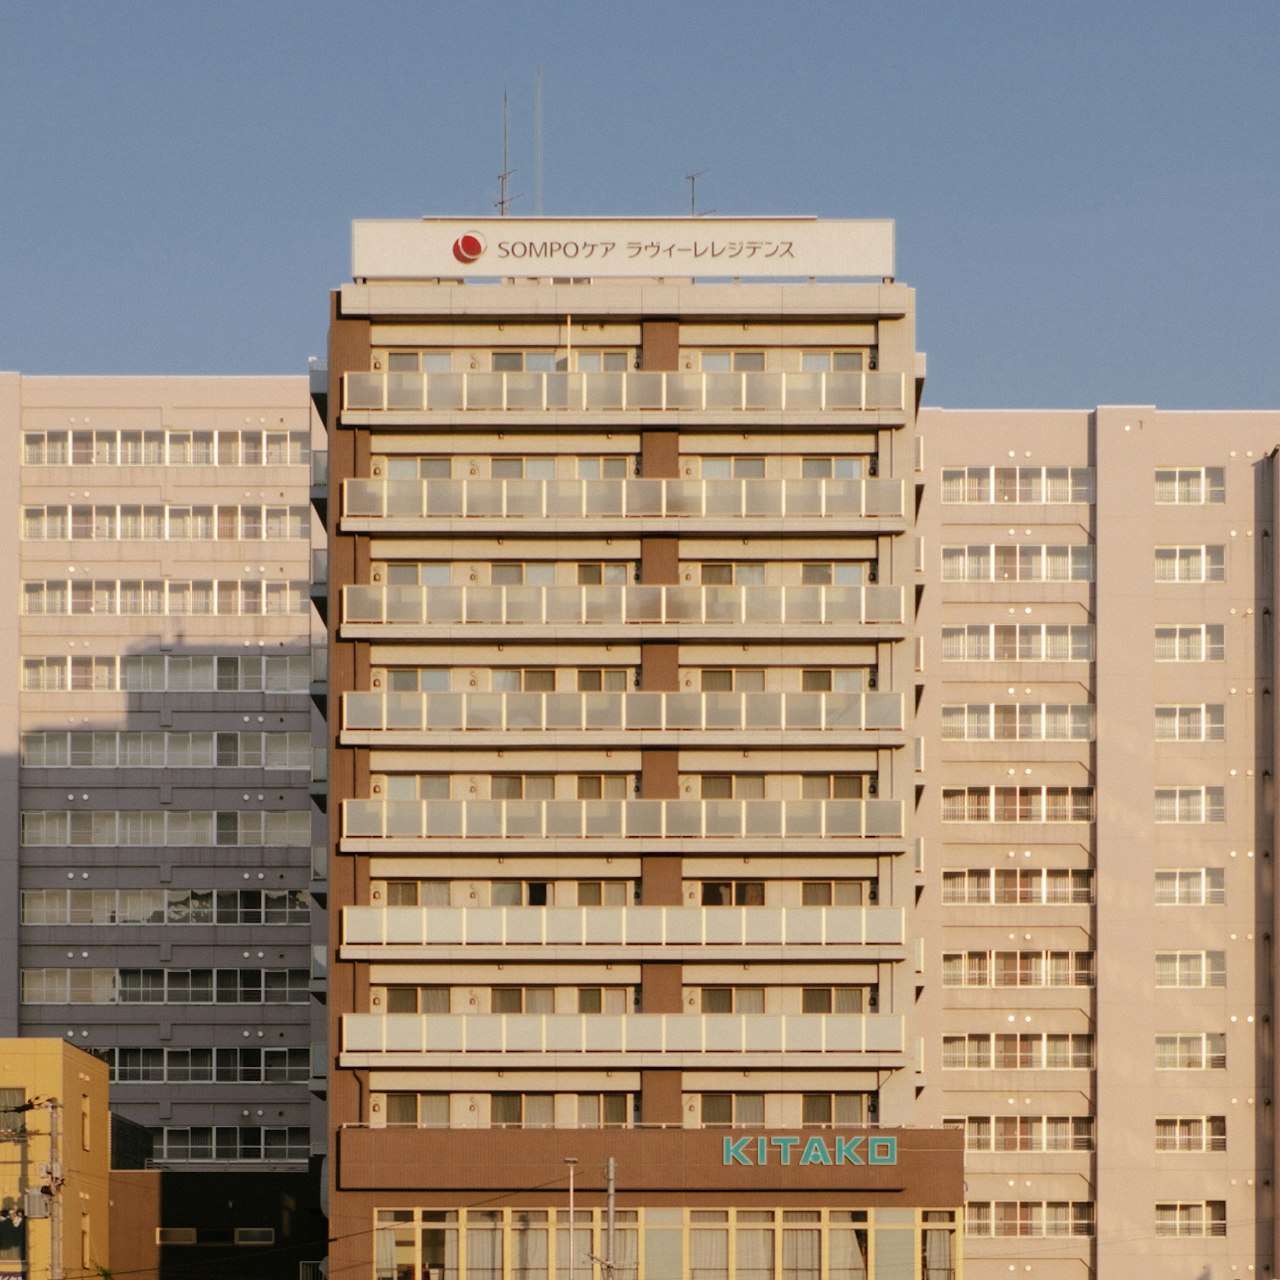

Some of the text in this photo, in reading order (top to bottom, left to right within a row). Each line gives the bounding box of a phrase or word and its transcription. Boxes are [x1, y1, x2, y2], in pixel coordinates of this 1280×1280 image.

[497, 240, 795, 260] SOMPOケア ラヴィーレレジデンス
[722, 1135, 898, 1167] KITAKO
